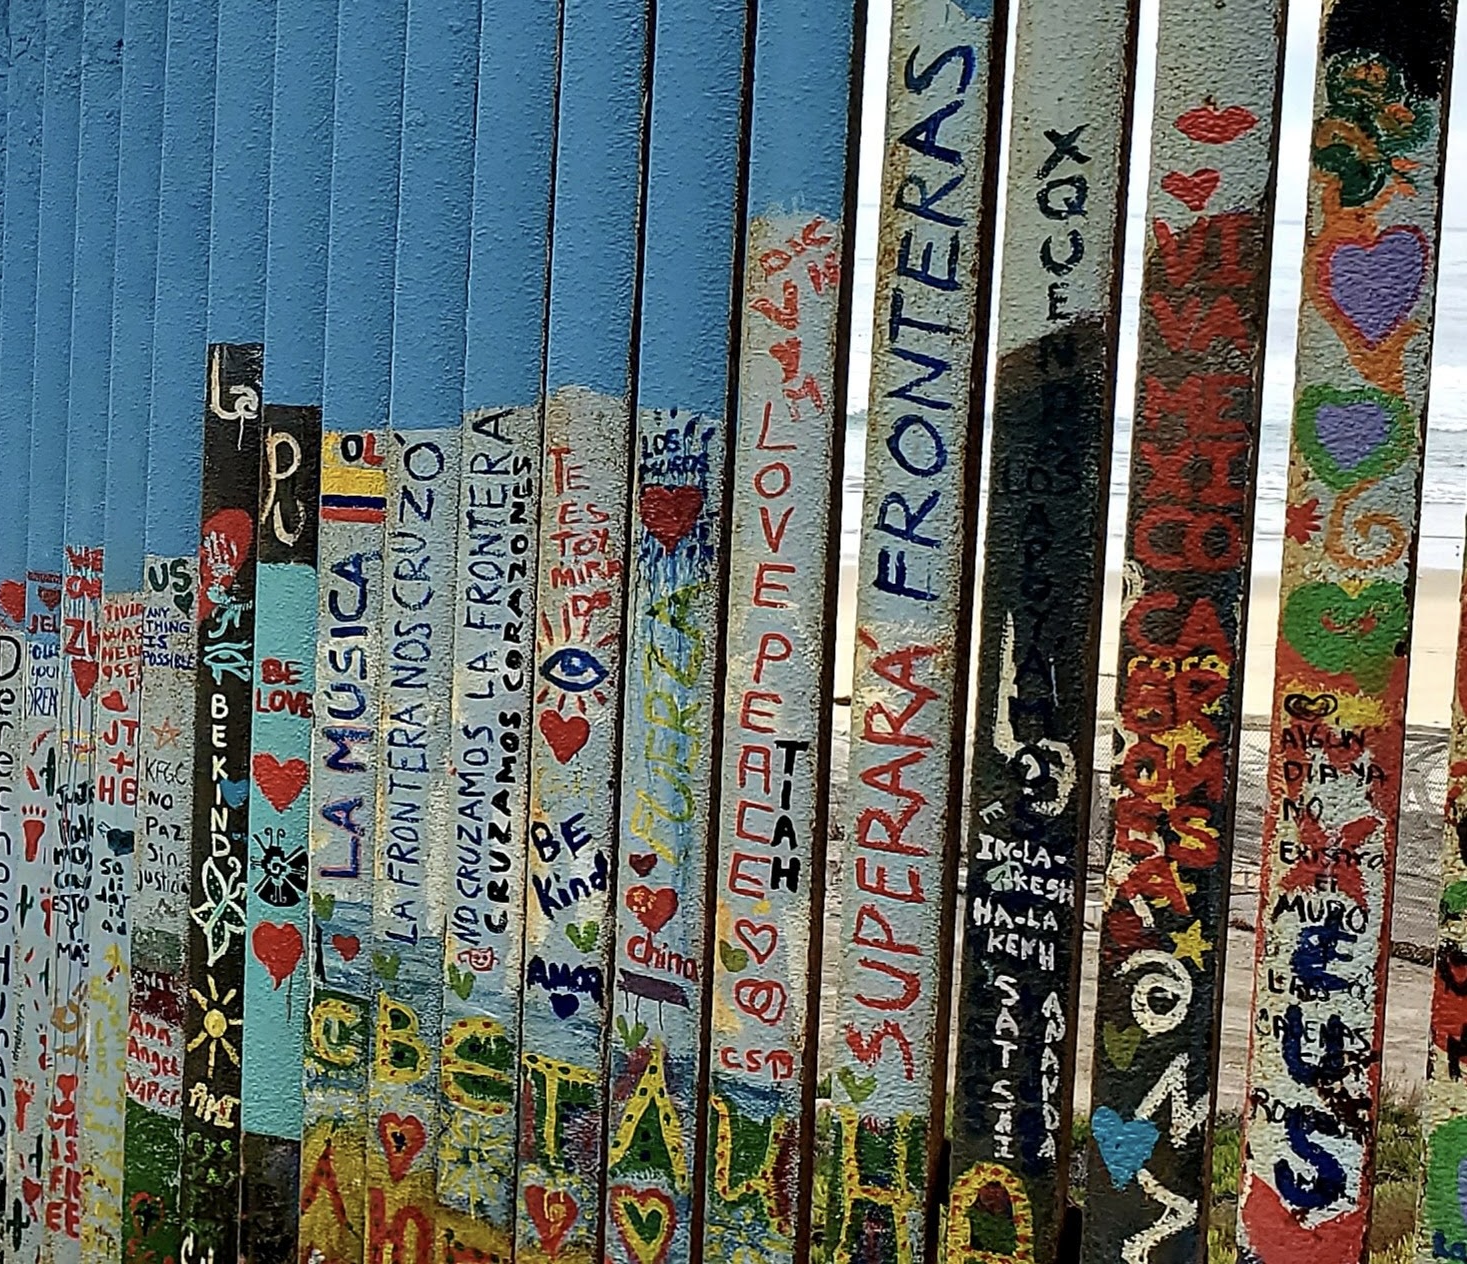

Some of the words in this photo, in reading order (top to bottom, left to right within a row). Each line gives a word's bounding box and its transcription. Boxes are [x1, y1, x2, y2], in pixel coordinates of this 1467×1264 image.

[874, 44, 975, 601] FRONTERAS
[464, 407, 516, 631] FRONTERA
[501, 455, 533, 693] CORAZONES
[752, 402, 797, 608] LOVE
[387, 703, 430, 888] FRONTERA
[455, 724, 495, 899] CRUZAMOS
[484, 711, 522, 935] CRUZAMOS
[727, 632, 794, 899] PEACE
[386, 900, 419, 946] LA
